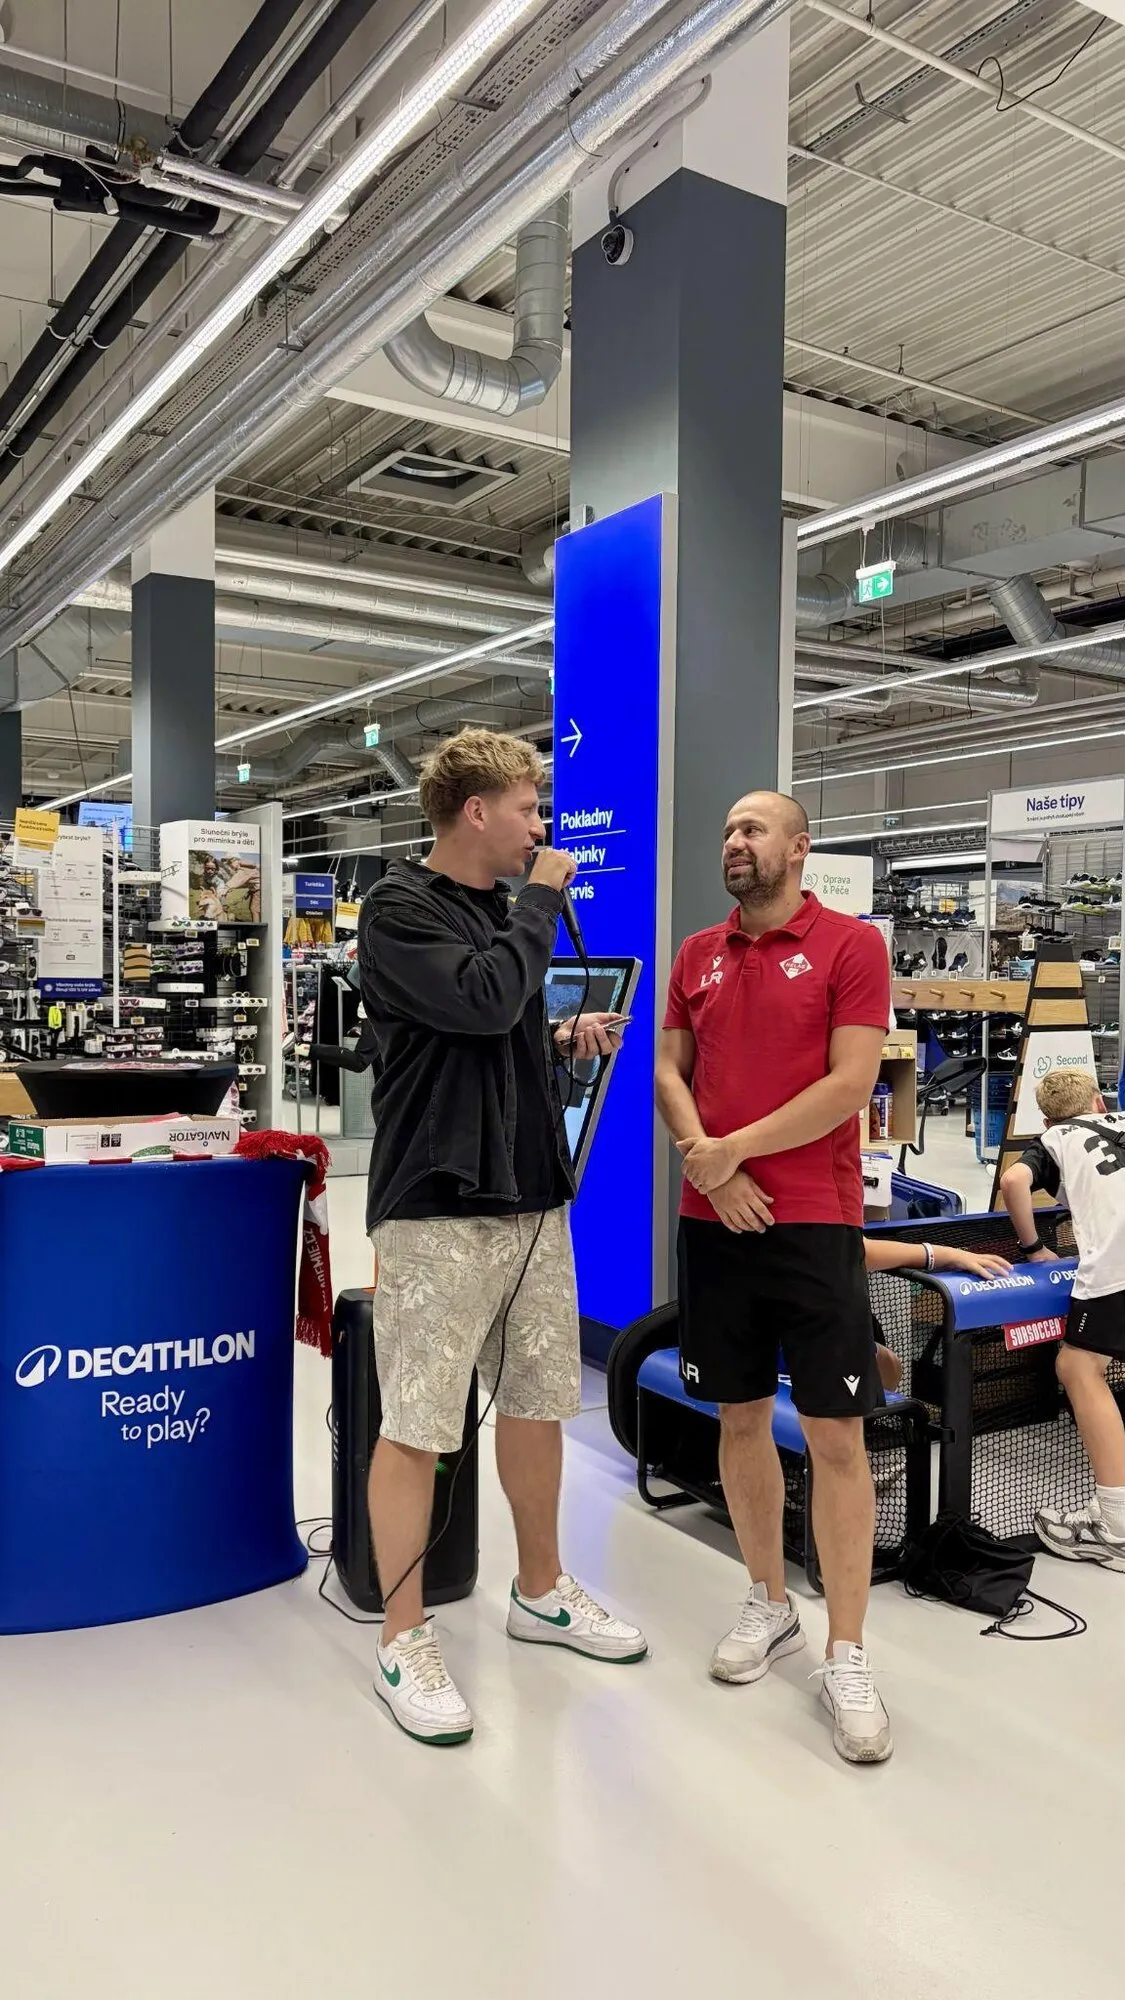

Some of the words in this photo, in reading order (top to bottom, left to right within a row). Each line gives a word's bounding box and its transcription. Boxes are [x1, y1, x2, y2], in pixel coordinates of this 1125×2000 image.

[1026, 795, 1058, 812] Naše
[1060, 793, 1085, 811] tipy
[560, 807, 613, 831] Pokladny
[200, 828, 231, 837] Sluneční
[231, 830, 249, 838] brýle
[241, 838, 255, 846] děti
[560, 844, 606, 866] abinky
[822, 874, 851, 885] Oprava
[568, 881, 595, 901] ervis
[822, 885, 829, 895] &
[830, 885, 850, 895] Péče
[700, 971, 724, 988] LR
[1056, 1055, 1088, 1065] Second
[168, 1130, 231, 1143] NAVIGATOR
[973, 1275, 1036, 1293] DECATHLON
[1010, 1317, 1062, 1347] SUBSOCCER
[67, 1329, 255, 1380] DECATHLON
[101, 1384, 186, 1417] Ready
[120, 1423, 142, 1441] to
[146, 1407, 211, 1449] play?
